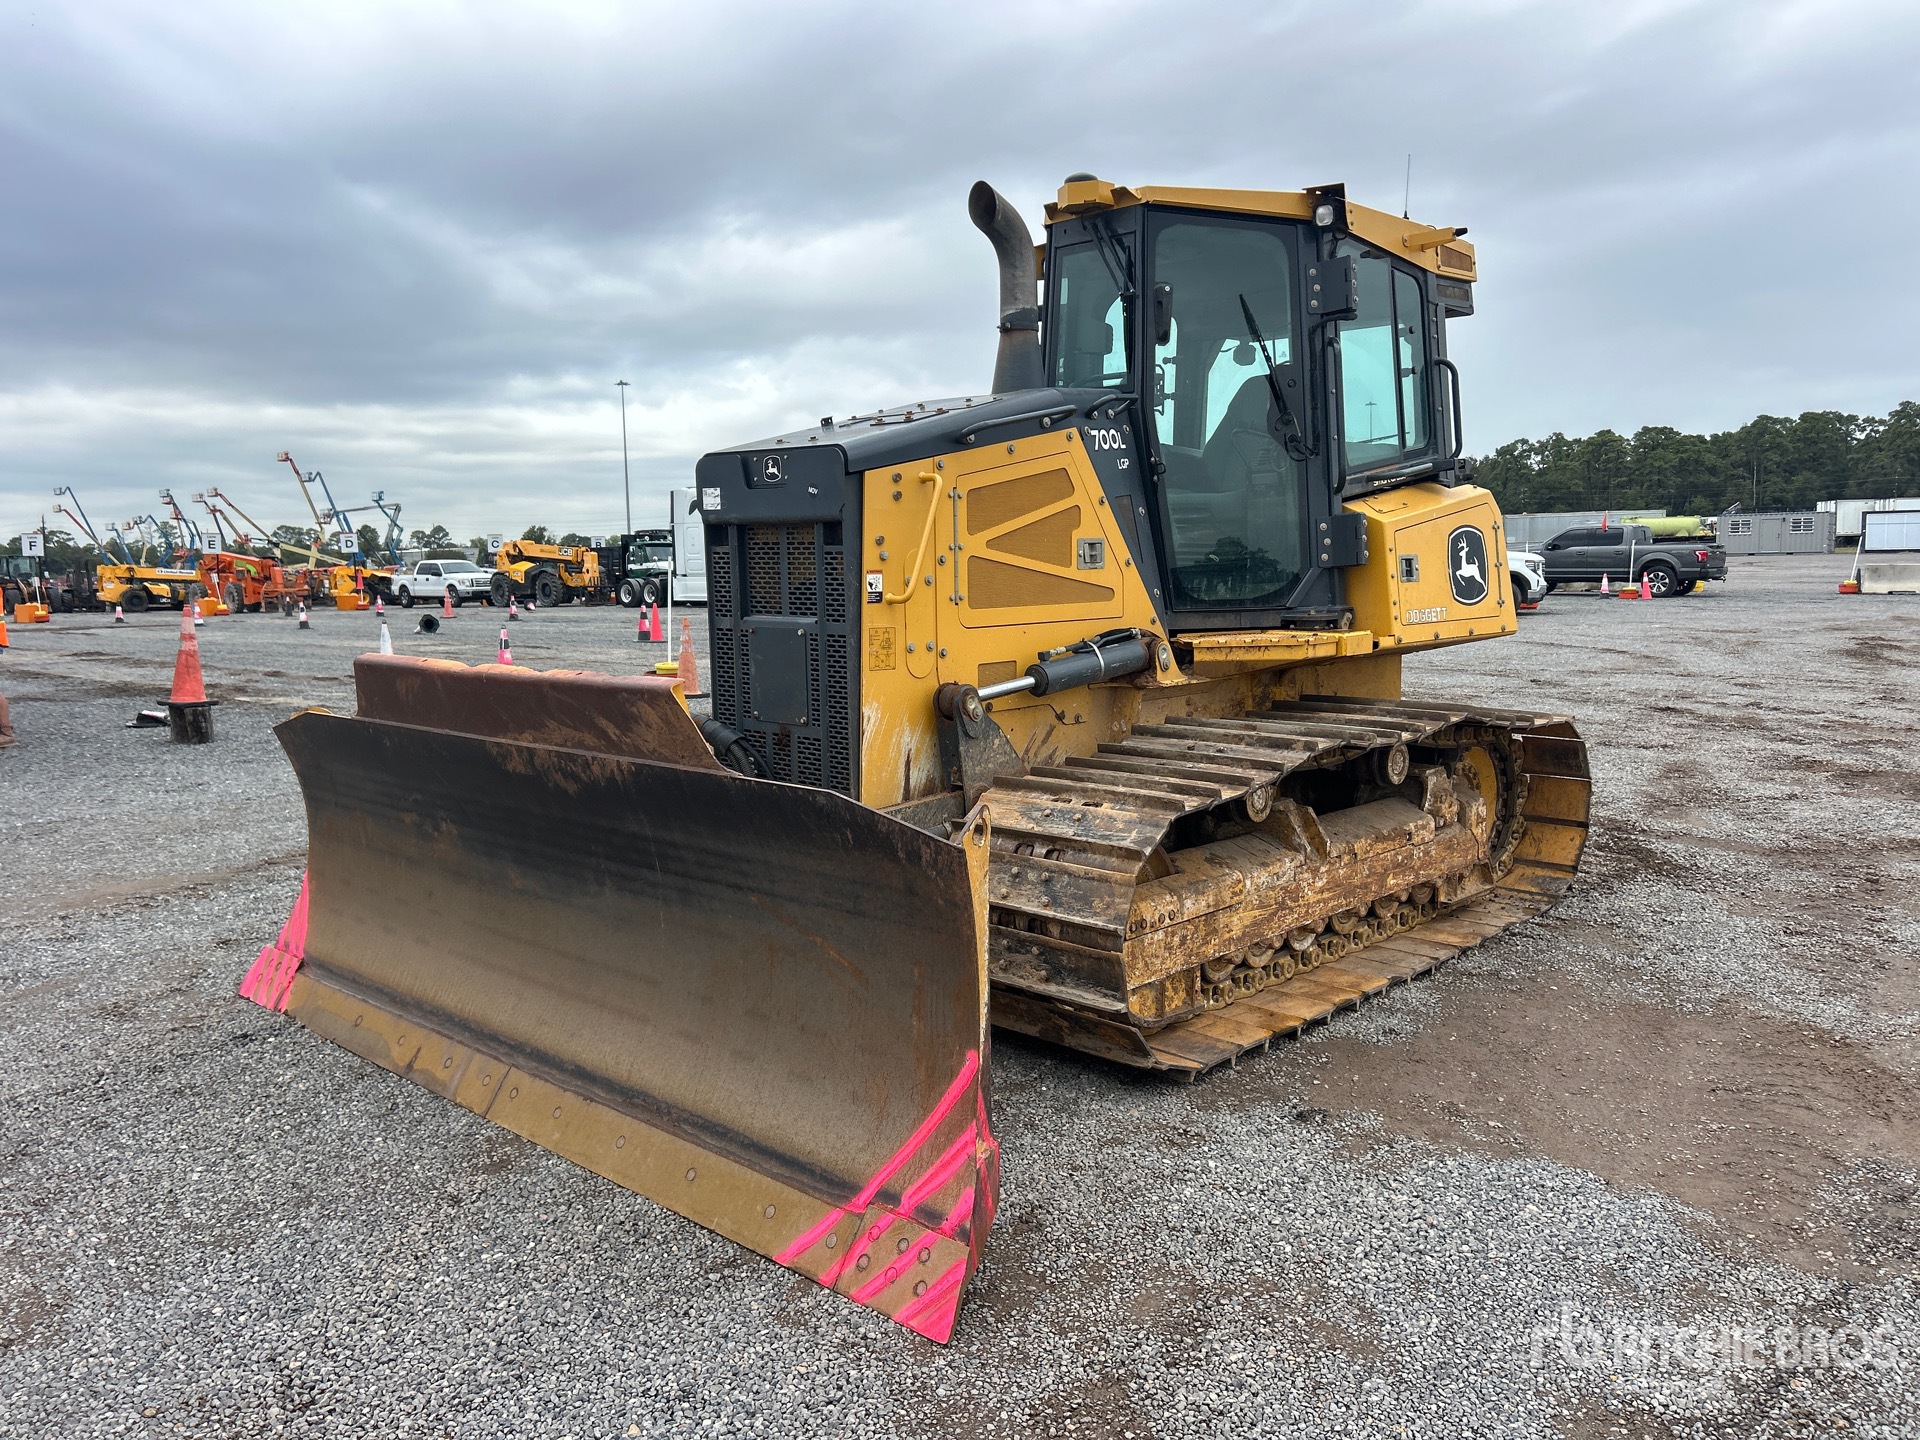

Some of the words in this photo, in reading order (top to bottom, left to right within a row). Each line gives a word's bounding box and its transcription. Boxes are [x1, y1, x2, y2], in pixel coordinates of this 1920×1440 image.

[1090, 428, 1127, 451] 700L
[1116, 458, 1129, 470] LGP
[807, 486, 819, 495] NOV
[28, 540, 37, 551] F
[208, 540, 217, 550] E
[345, 539, 354, 549] D
[491, 540, 500, 549] C
[558, 548, 573, 556] JCB
[1406, 607, 1447, 623] DOGGETT
